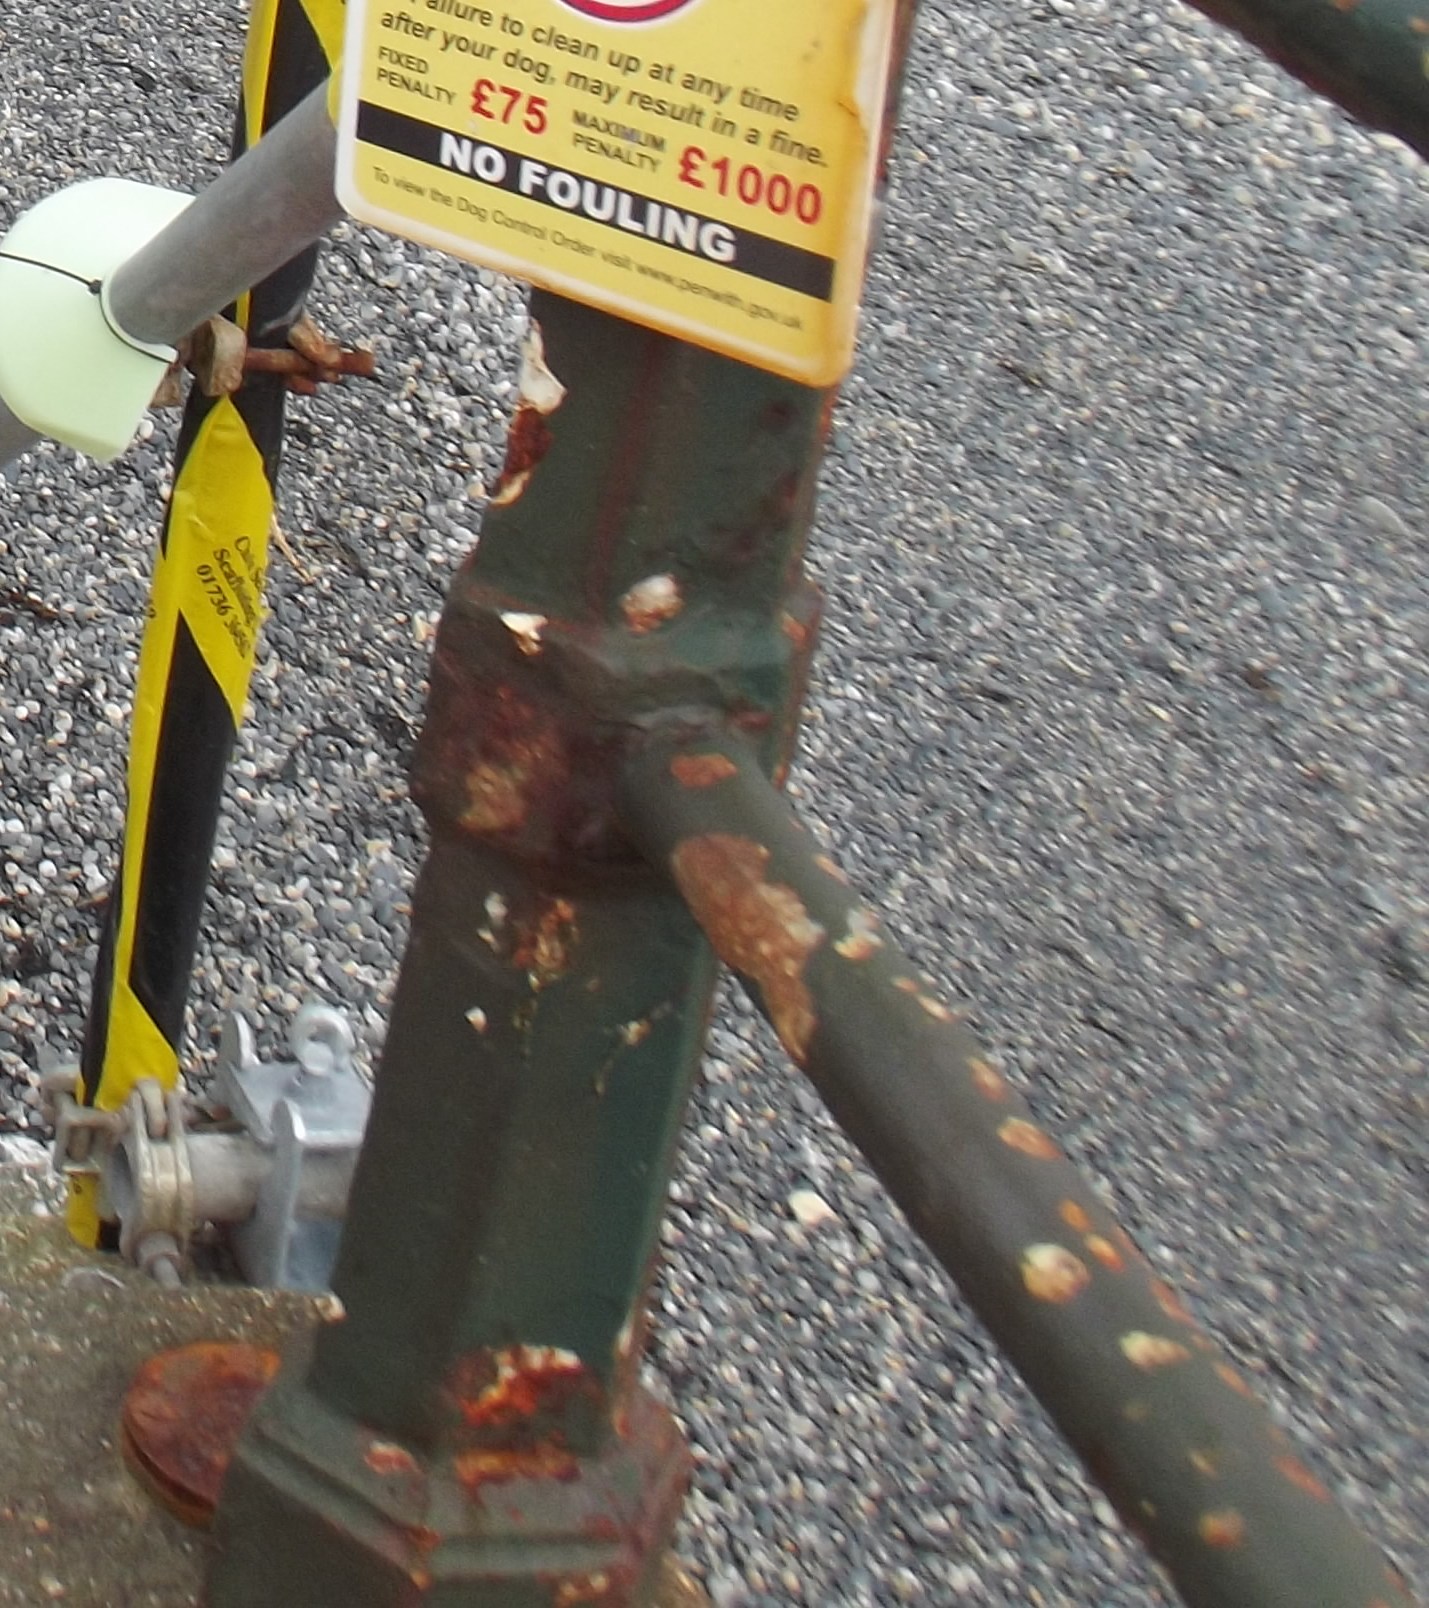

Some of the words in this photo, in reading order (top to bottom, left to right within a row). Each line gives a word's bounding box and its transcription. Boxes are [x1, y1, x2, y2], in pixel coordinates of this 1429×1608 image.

[376, 66, 458, 107] PENALTY
[377, 45, 430, 76] FIXED
[380, 11, 437, 42] after
[438, 30, 499, 62] your
[503, 48, 557, 86] dog,
[564, 70, 621, 105] may
[626, 89, 706, 129] result
[710, 110, 738, 138] in
[744, 126, 762, 146] a
[768, 128, 829, 168] fine.
[500, 13, 525, 38] to
[530, 25, 600, 62] clean
[607, 48, 641, 77] up
[648, 60, 676, 86] at
[681, 72, 734, 106] any
[738, 86, 801, 123] time
[469, 77, 550, 136] £75
[572, 109, 667, 153] MAXIMUM
[572, 132, 664, 174] PENALTY
[439, 131, 508, 185] NO
[518, 158, 738, 264] FOULING
[677, 144, 823, 226] £1000
[372, 166, 391, 186] To
[393, 176, 426, 198] view
[428, 187, 454, 208] the
[457, 195, 488, 224] Dog
[492, 208, 548, 241] Control
[551, 229, 597, 258] Order
[600, 249, 634, 272] visit
[196, 564, 234, 617] 01736
